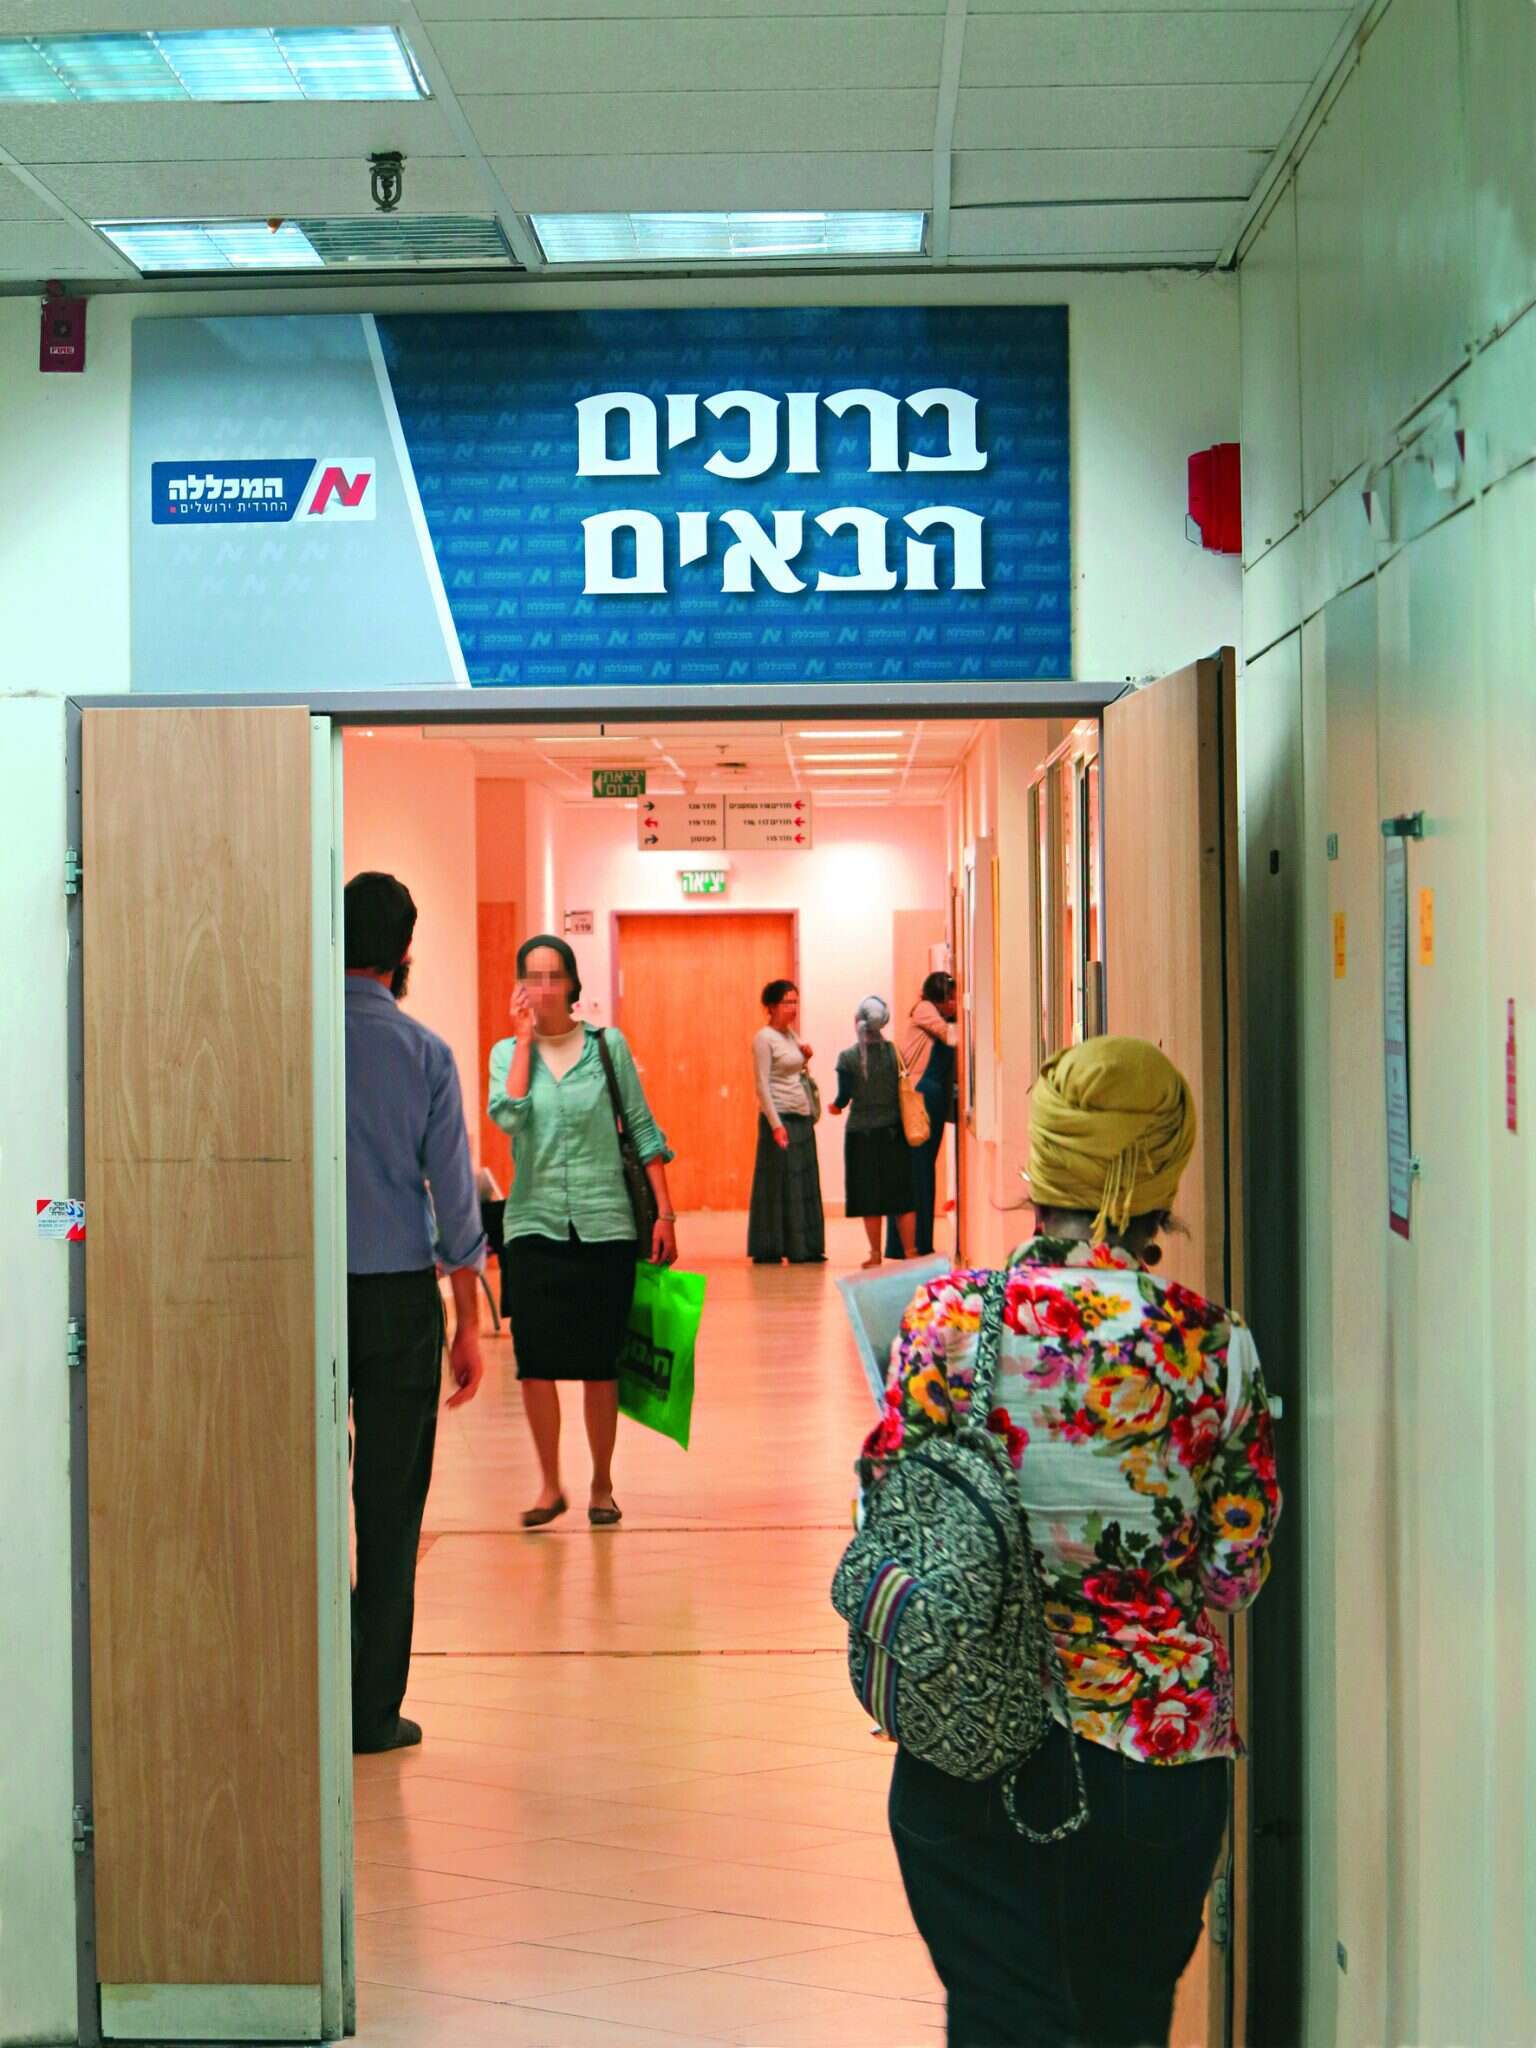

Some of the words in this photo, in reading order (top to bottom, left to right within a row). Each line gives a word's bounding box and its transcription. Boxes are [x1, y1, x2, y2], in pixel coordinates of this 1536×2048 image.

[574, 388, 988, 479] ברוכים
[168, 474, 283, 501] המכללה
[236, 501, 288, 513] החרדית
[580, 506, 988, 594] הבאים
[682, 871, 725, 893] יציאה
